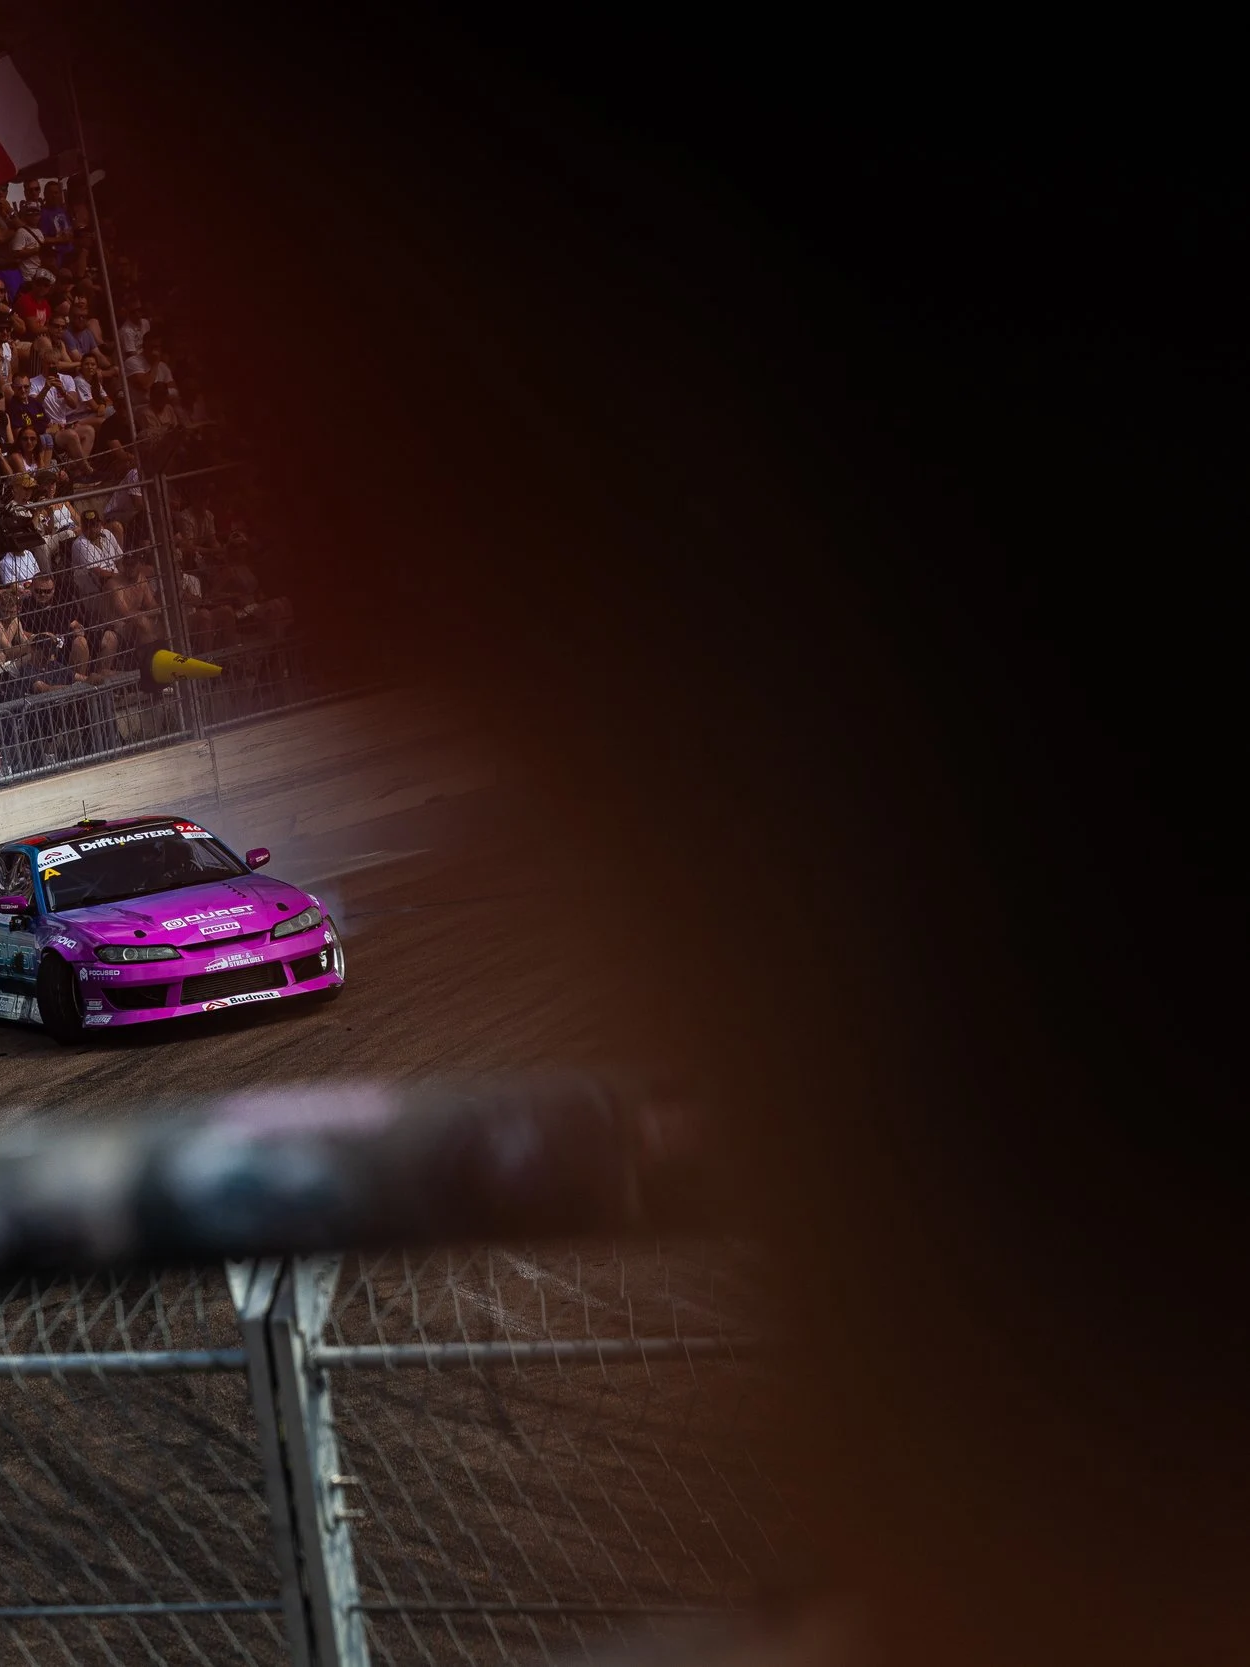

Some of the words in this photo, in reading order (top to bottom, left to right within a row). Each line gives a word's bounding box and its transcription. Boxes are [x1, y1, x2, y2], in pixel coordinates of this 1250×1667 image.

[44, 868, 61, 881] A
[184, 904, 254, 922] DURST
[203, 923, 239, 935] MOTUL
